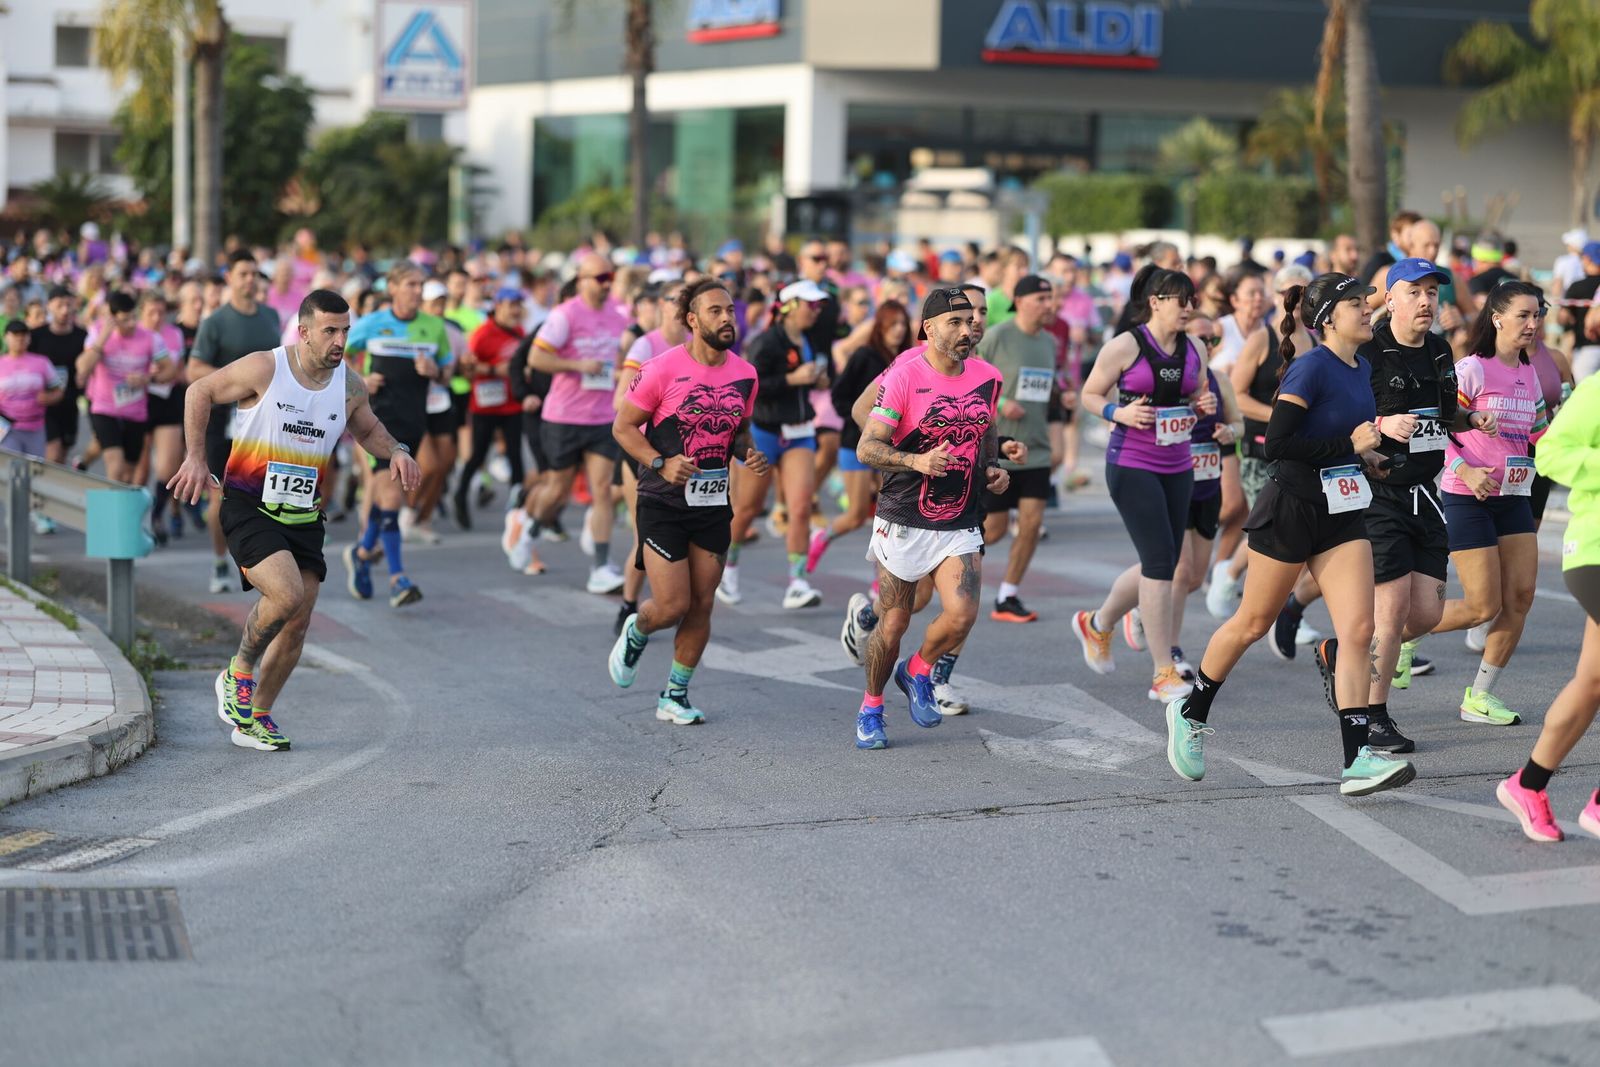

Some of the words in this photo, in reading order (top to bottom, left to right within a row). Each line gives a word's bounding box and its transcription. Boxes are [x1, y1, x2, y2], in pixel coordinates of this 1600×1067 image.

[985, 0, 1162, 57] ALDI
[1487, 396, 1516, 411] MEDIA
[282, 422, 326, 439] MARATHON
[1508, 467, 1529, 483] 820
[270, 474, 314, 495] 1125
[690, 479, 727, 494] 1426
[1338, 478, 1359, 496] 84
